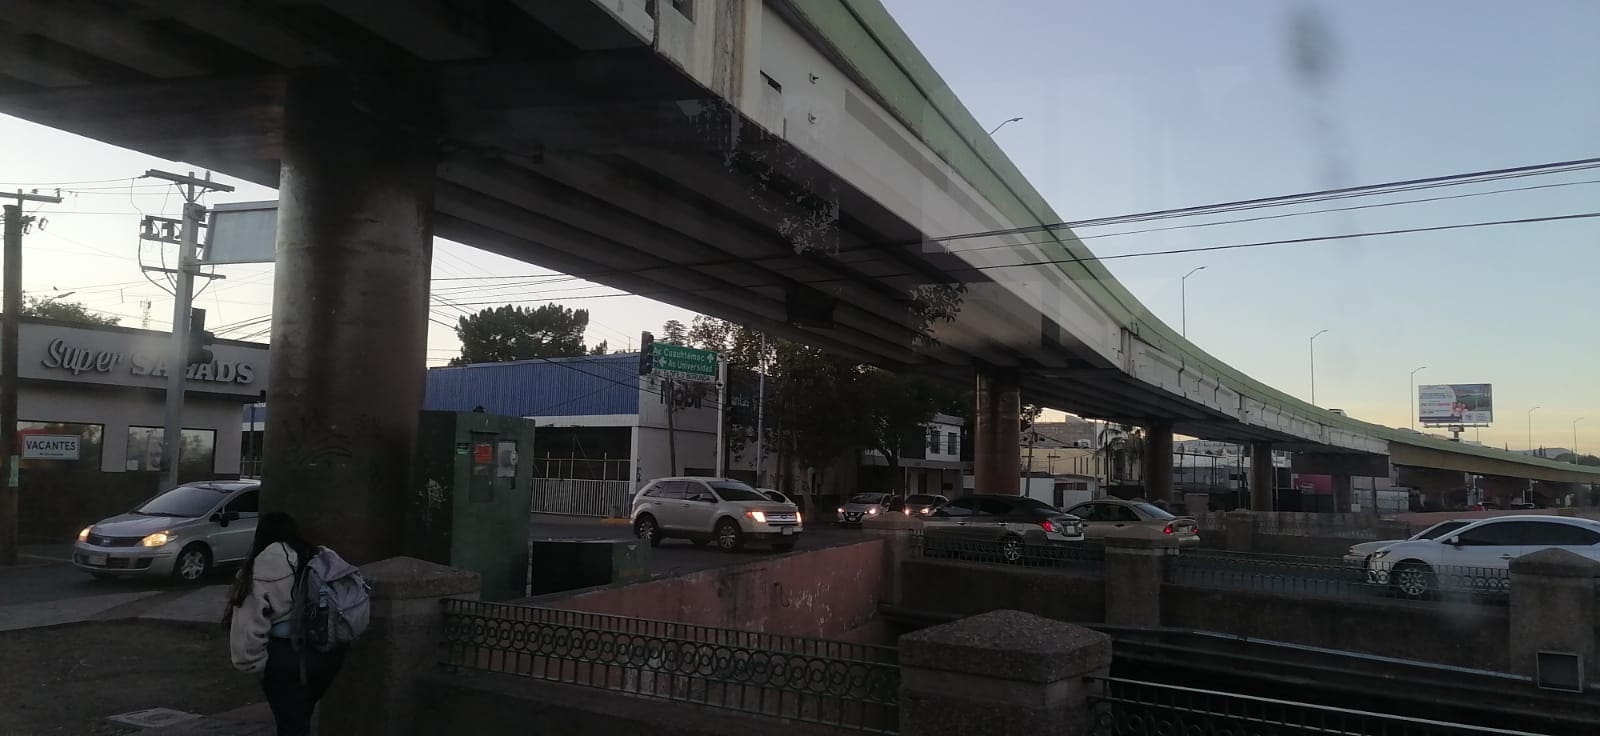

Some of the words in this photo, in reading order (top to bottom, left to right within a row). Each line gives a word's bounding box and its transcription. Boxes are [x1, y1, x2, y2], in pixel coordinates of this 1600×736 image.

[42, 338, 120, 375] Super
[663, 348, 705, 361] Cuauhtémoc
[677, 360, 713, 373] Universidad
[26, 440, 76, 451] VACANTES
